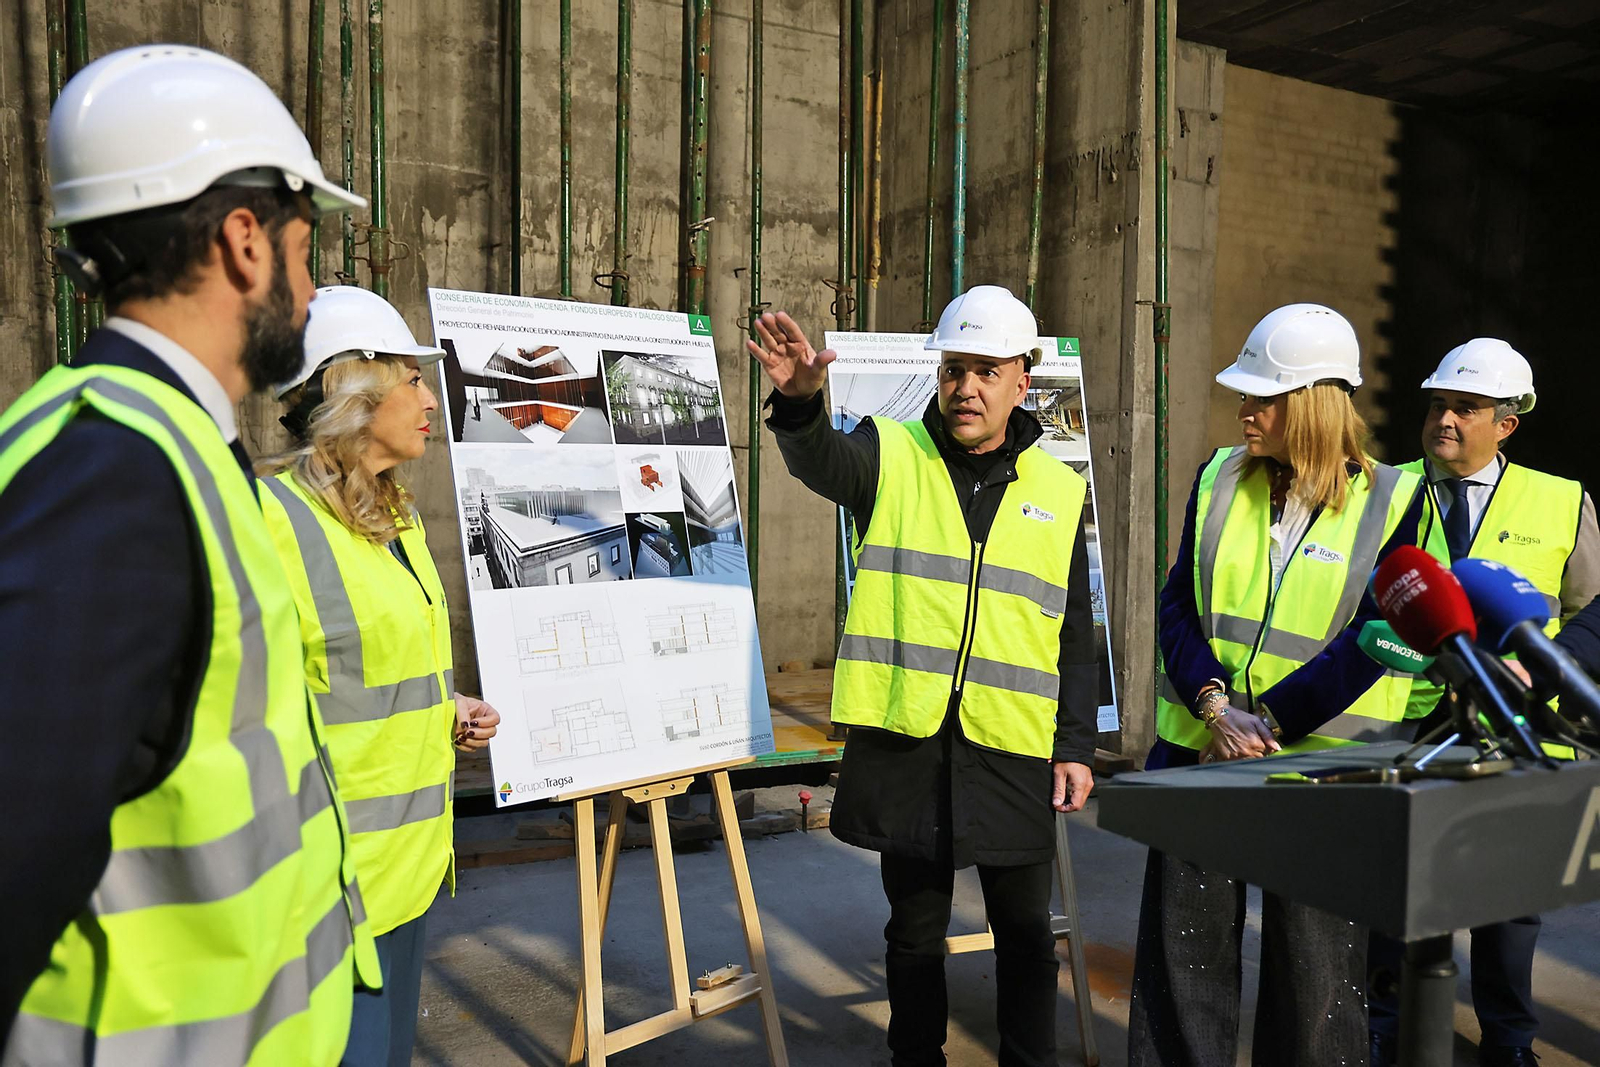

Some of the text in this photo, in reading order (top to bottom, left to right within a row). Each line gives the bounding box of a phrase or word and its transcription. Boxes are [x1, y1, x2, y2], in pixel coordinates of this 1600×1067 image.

[435, 292, 482, 304] CONSEJERÍA
[483, 296, 493, 305] DE
[570, 305, 598, 315] FONDOS
[599, 308, 633, 318] EUROPEOS
[666, 314, 687, 324] SOCIAL
[436, 303, 535, 319] Dirección General de Patrimonio
[438, 320, 474, 330] PROYECTO
[538, 328, 561, 336] EDIFICIO
[829, 334, 868, 343] CONSEJERÍA
[869, 335, 878, 343] DE
[1034, 507, 1054, 521] Tragsa
[1513, 533, 1541, 545] Tragsa
[1319, 547, 1344, 562] Tragsa
[1381, 568, 1420, 606] europa
[1392, 581, 1428, 616] press
[1376, 637, 1424, 662] TELEONUBA
